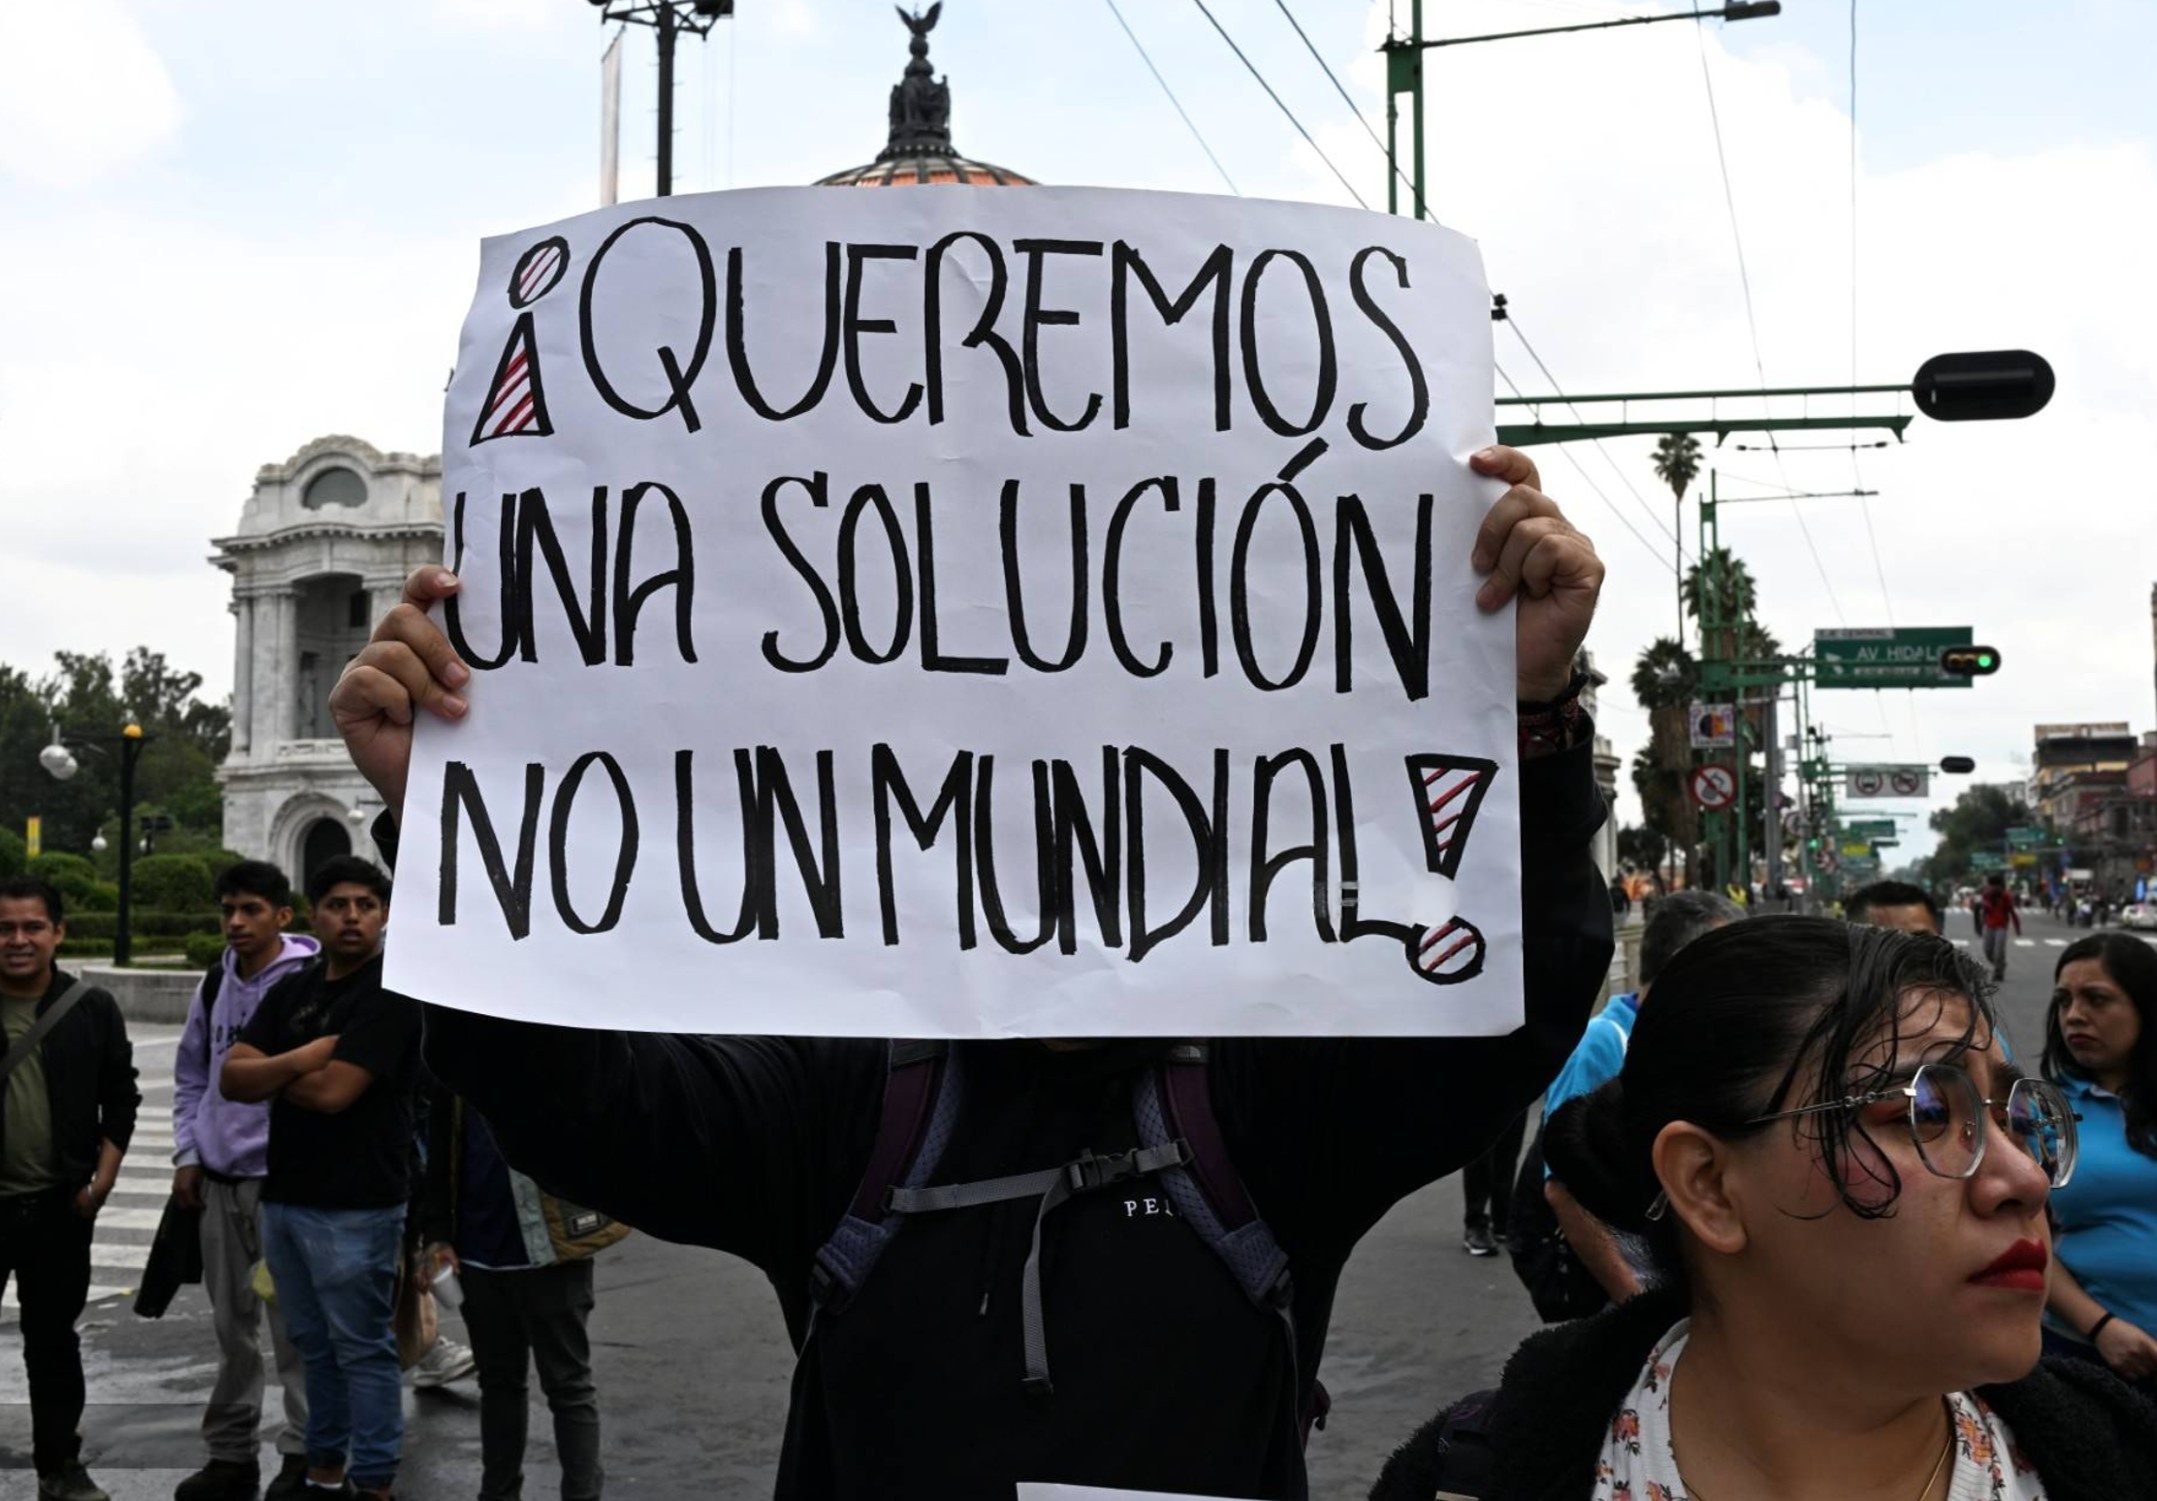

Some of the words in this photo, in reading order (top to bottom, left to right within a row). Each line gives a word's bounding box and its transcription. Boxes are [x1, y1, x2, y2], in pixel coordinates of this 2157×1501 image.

[443, 481, 698, 672] UNA
[760, 436, 1434, 703] SOLUCIÓN
[1855, 646, 1880, 662] AV
[438, 751, 640, 941] NO
[674, 744, 845, 945] UN
[871, 742, 1500, 986] MUNDIAL!
